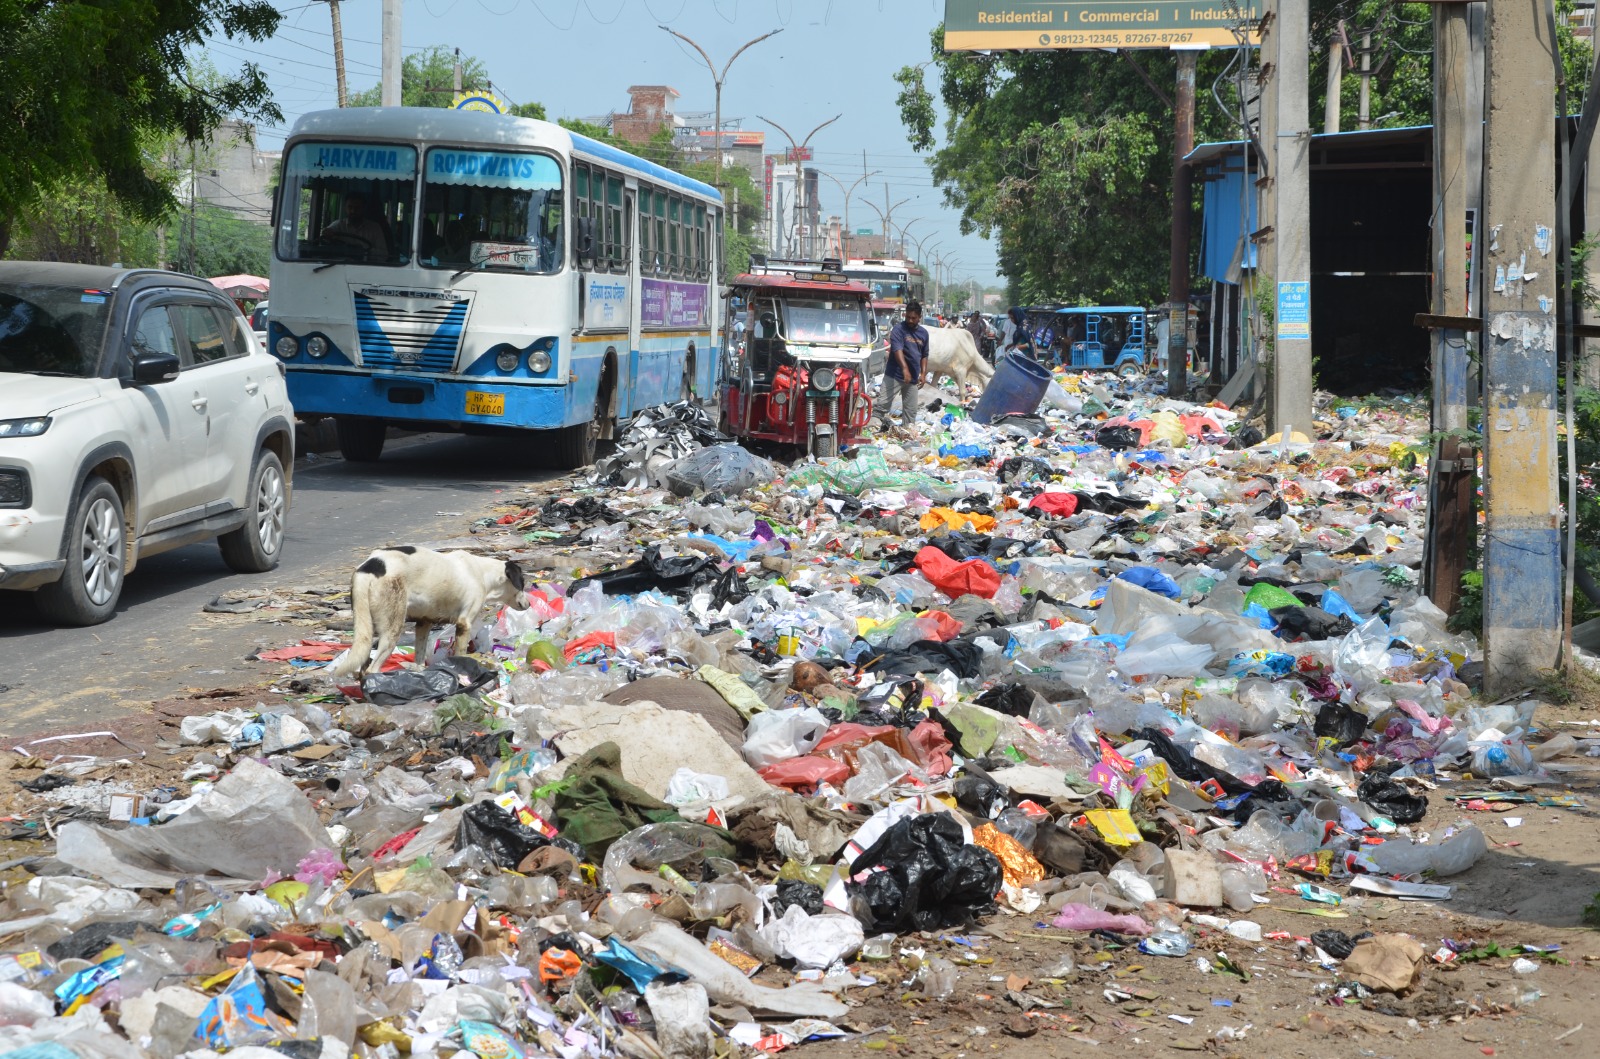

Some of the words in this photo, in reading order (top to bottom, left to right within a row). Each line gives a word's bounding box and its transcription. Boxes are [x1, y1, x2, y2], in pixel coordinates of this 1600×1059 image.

[978, 10, 1053, 24] Residential
[1079, 9, 1160, 23] Commercial
[1054, 33, 1123, 45] 98123-12345,
[1125, 32, 1194, 44] 87267-87267
[319, 147, 397, 171] HARYANA
[434, 153, 535, 179] ROADWAYS
[361, 288, 401, 297] ASHOK
[407, 290, 462, 301] LEYLAND
[474, 393, 484, 403] HR
[488, 394, 499, 404] 57
